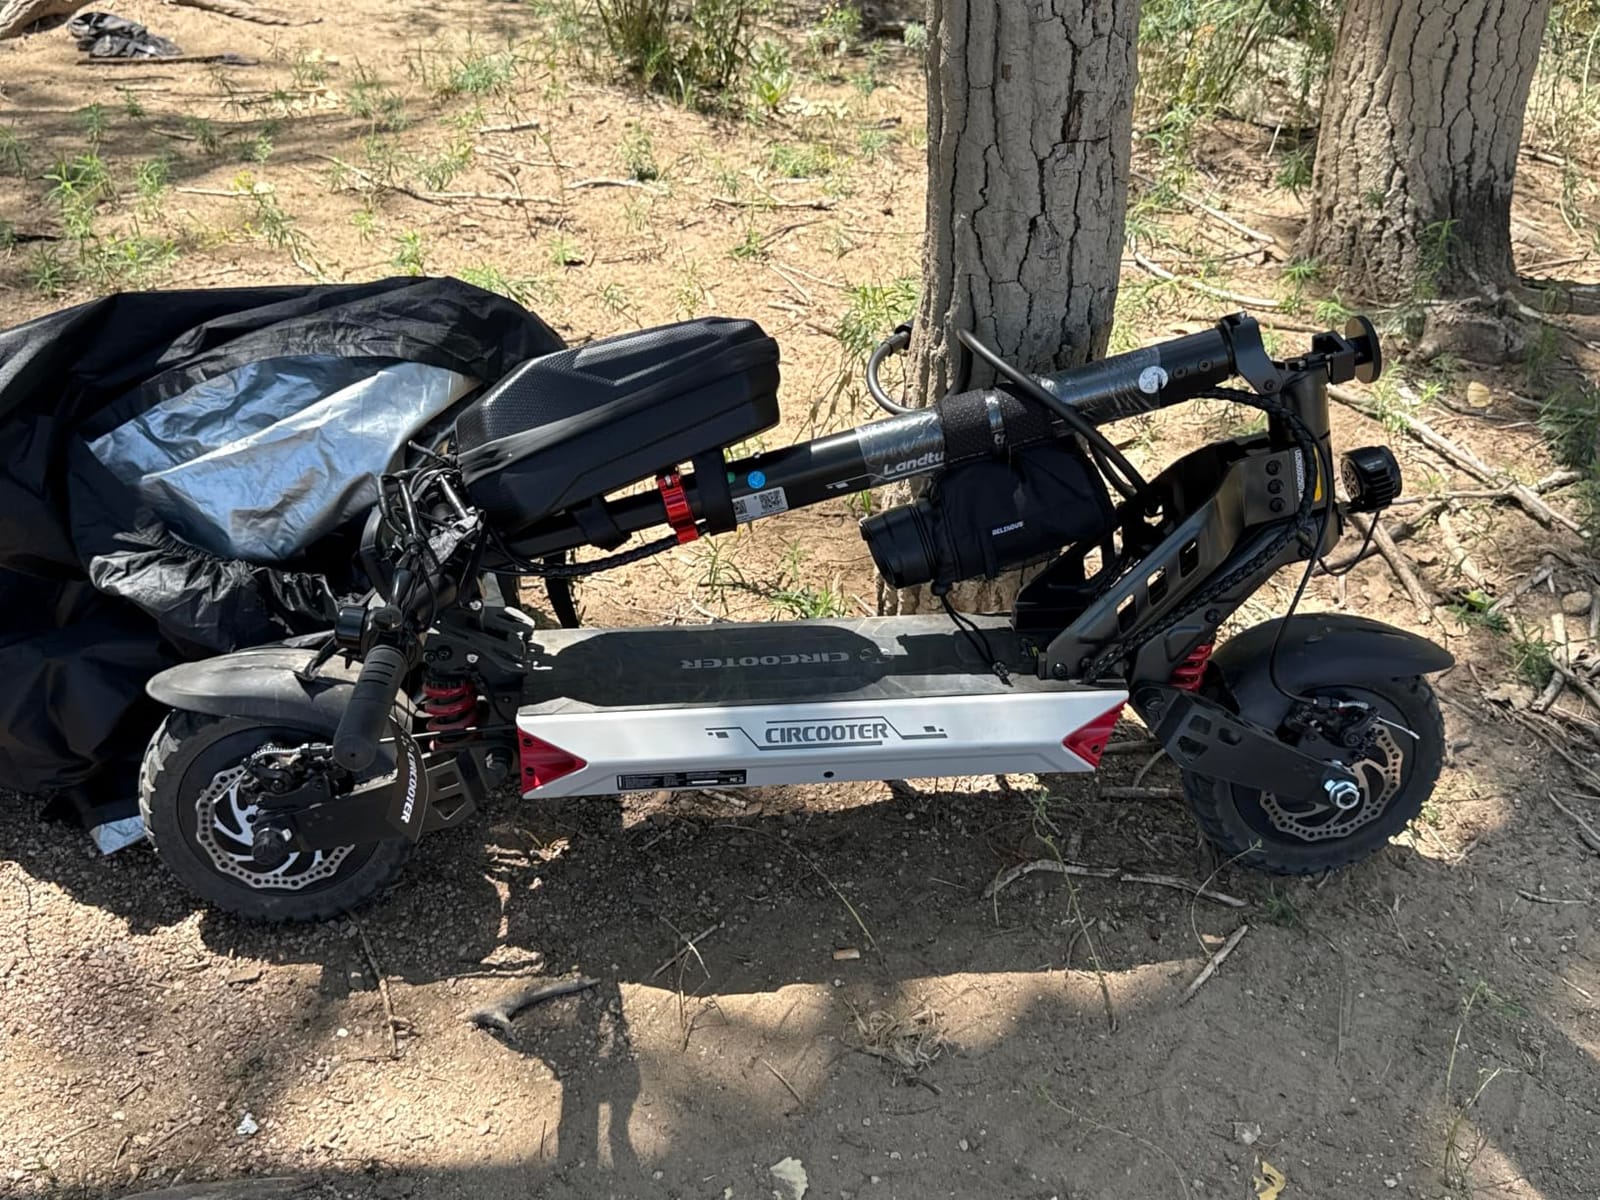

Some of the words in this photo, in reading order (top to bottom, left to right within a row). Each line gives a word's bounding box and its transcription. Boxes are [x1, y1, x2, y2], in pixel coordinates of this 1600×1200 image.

[680, 651, 849, 669] CIRCOOTER
[765, 723, 889, 743] CIRCOOTER
[401, 752, 418, 823] CIRCOOTER
